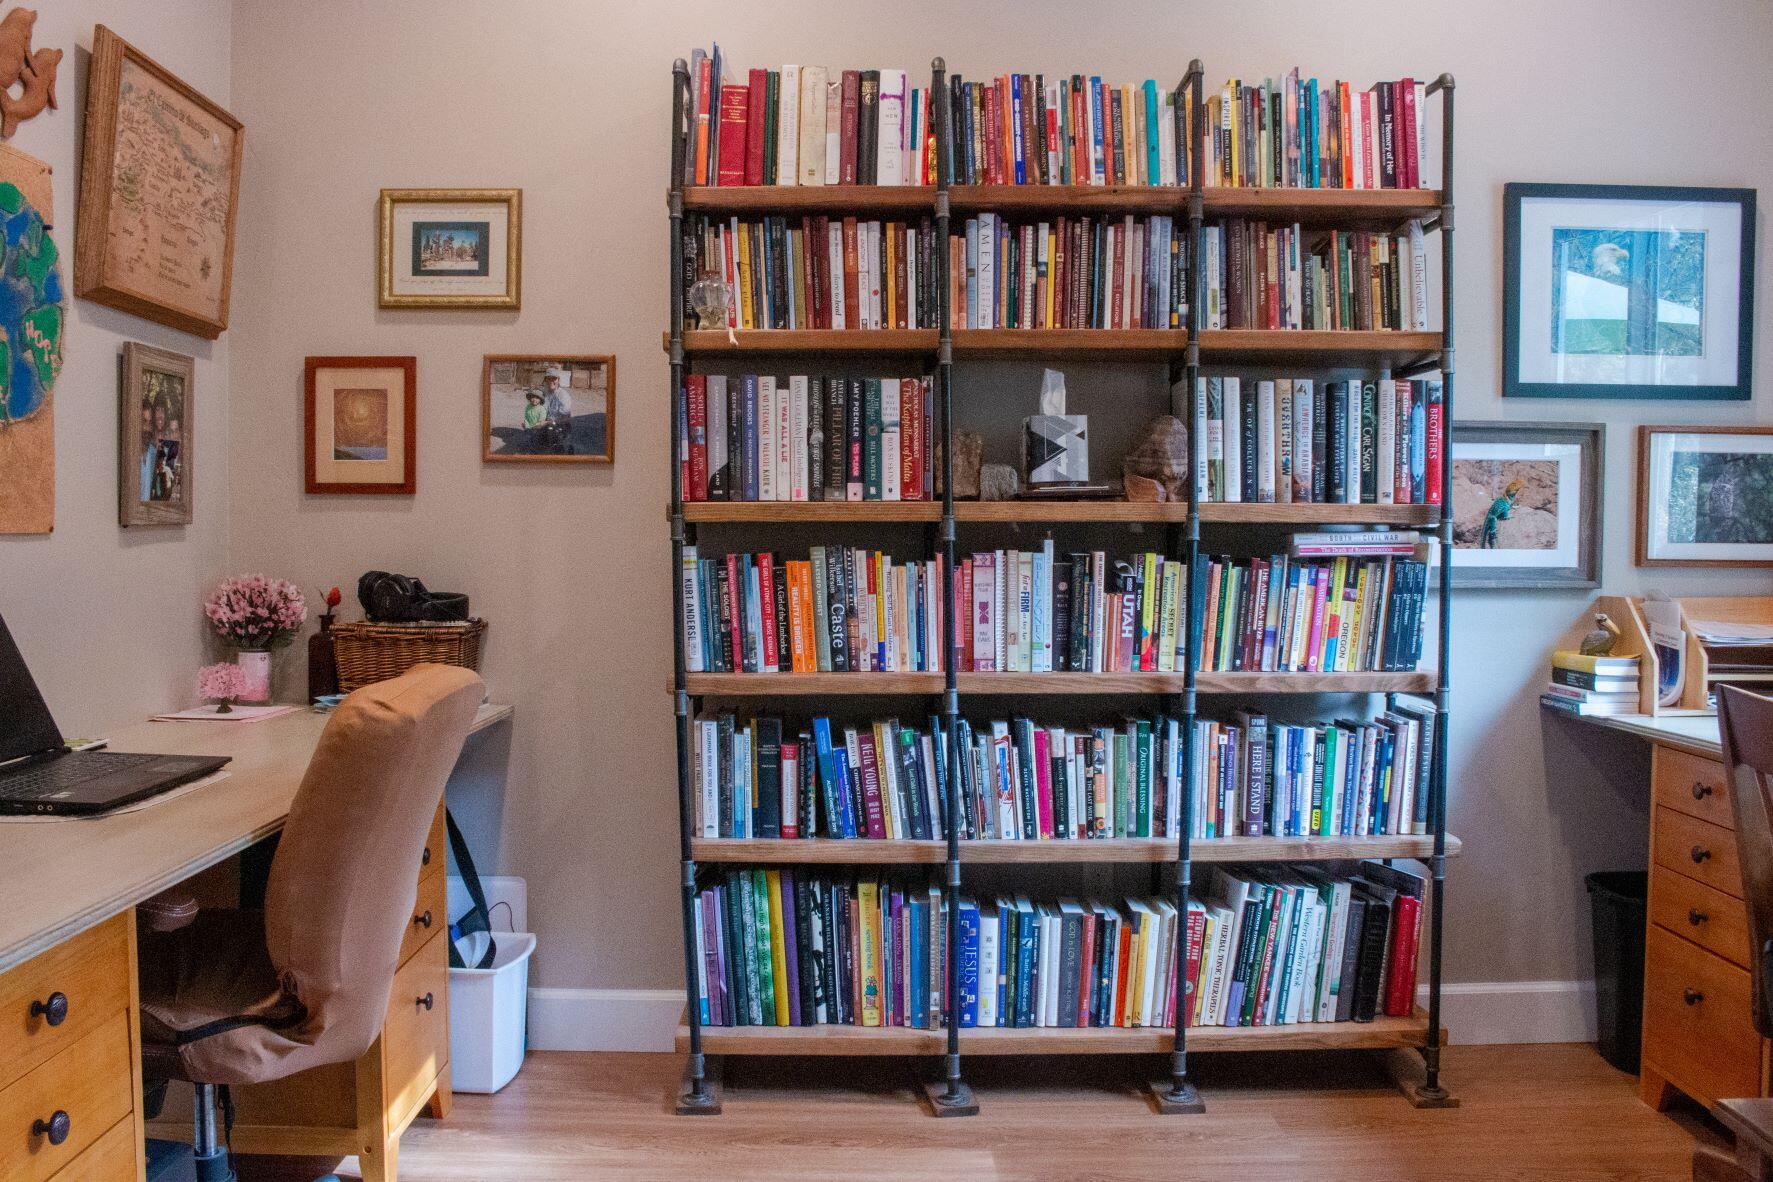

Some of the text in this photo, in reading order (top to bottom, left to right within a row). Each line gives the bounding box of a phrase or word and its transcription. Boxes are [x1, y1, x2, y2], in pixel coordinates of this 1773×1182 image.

[973, 106, 980, 115] IN
[1223, 97, 1231, 127] INSPIRED
[1384, 114, 1392, 122] In
[1384, 122, 1393, 151] Memory
[1386, 152, 1393, 160] of
[981, 220, 991, 273] AMEN
[1414, 255, 1424, 314] Unbelievable
[688, 385, 696, 425] AMERICA
[762, 394, 770, 402] NO
[902, 385, 912, 483] The Kappillan of Malta
[1281, 397, 1290, 476] OVERTHROW
[1301, 403, 1310, 439] LAWRENCE
[1362, 427, 1372, 447] CARL
[1429, 408, 1438, 460] BROTHERS
[832, 407, 842, 488] PILLAR OF FIRE
[1362, 448, 1373, 472] SAGAN
[684, 578, 694, 600] KURT
[776, 591, 785, 604] Girl
[1020, 591, 1030, 613] FIRM
[1257, 583, 1268, 619] AMERICAN
[1315, 582, 1325, 626] WASHINGTON
[831, 603, 845, 649] Caste
[1121, 594, 1134, 638] UTAH
[1167, 608, 1175, 638] SECRET
[1256, 620, 1265, 640] RIVER
[779, 622, 787, 655] Limberlost
[793, 626, 802, 654] BROKEN
[1339, 622, 1349, 660] OREGON
[861, 743, 878, 796] NEIL YOUNG
[1139, 747, 1148, 781] ORIGINAL
[1252, 745, 1262, 774] HERE
[853, 768, 861, 803] CHRONICLES
[1250, 781, 1260, 814] STAND
[863, 928, 872, 954] sewing
[1269, 921, 1277, 941] NEW
[1293, 906, 1313, 989] Western Garden Book
[1326, 912, 1338, 960] Structural Geology
[964, 945, 977, 985] JESUS
[1208, 924, 1229, 1014] HERBAL TONIC THERAPIES
[1263, 942, 1274, 973] YANKEE
[1258, 972, 1268, 1004] WORKSHOP
